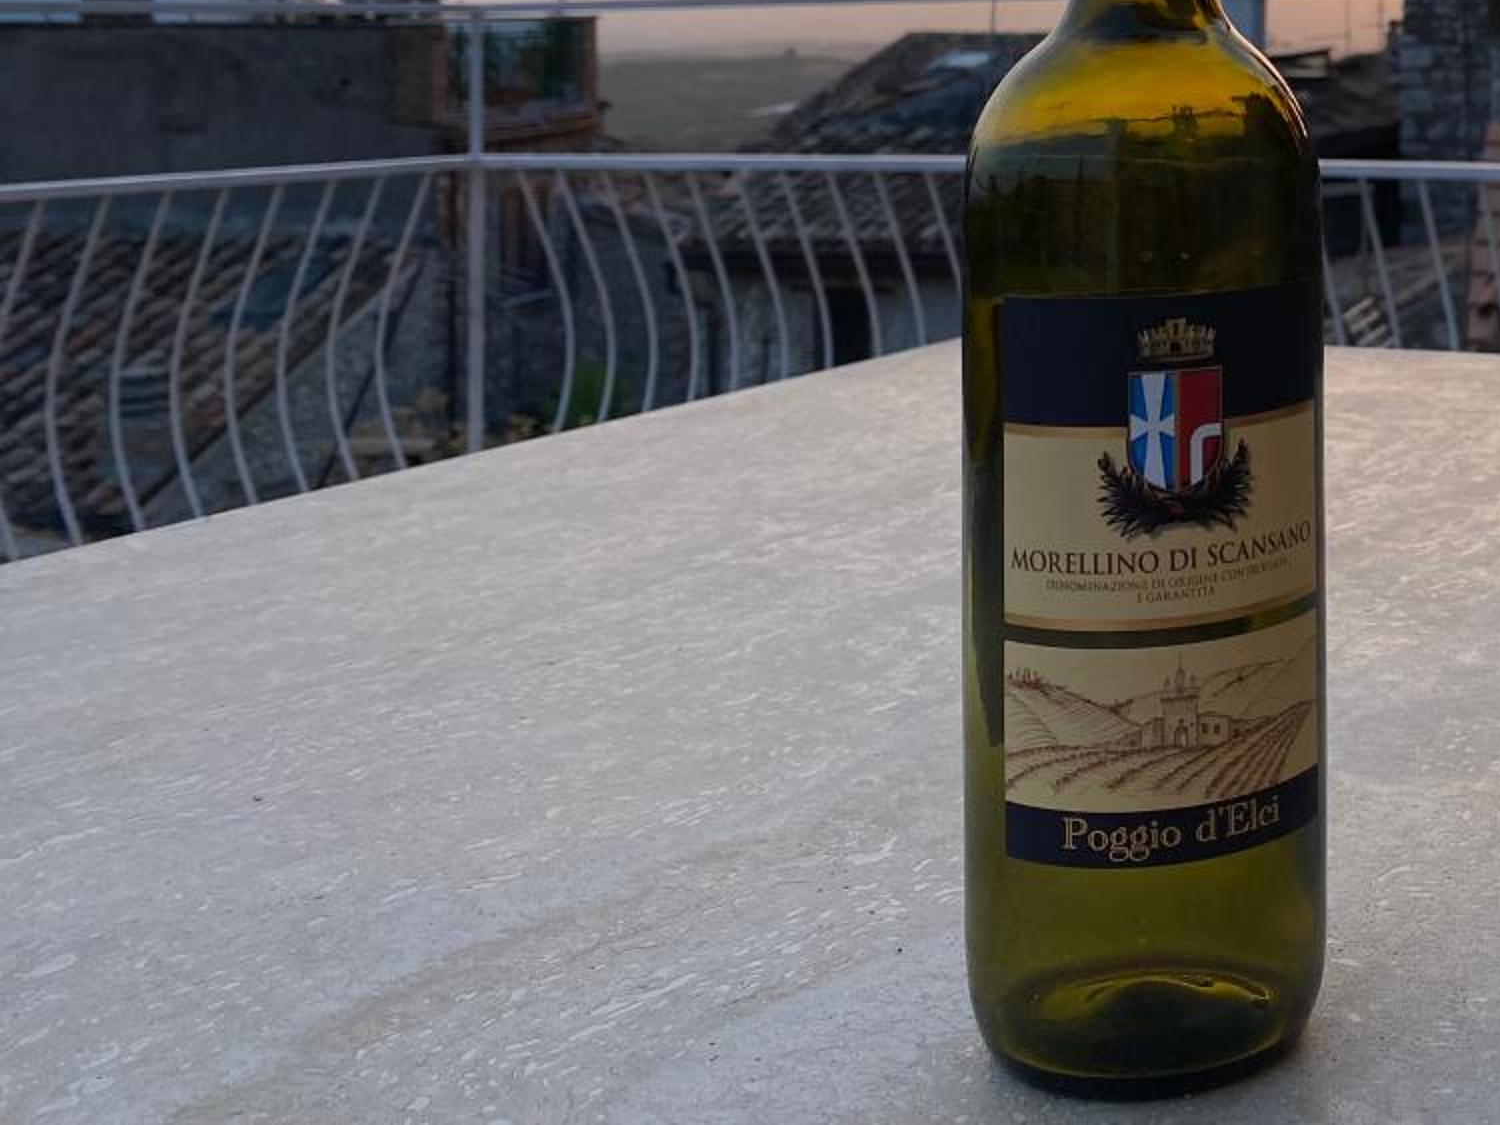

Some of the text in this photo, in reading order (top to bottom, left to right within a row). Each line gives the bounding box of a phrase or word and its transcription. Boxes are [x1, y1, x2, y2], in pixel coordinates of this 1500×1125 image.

[1011, 521, 1311, 575] MORELLINO DI SCANSANO
[1145, 586, 1216, 604] GARANTITA
[1062, 795, 1281, 862] Poggio d'Elci
